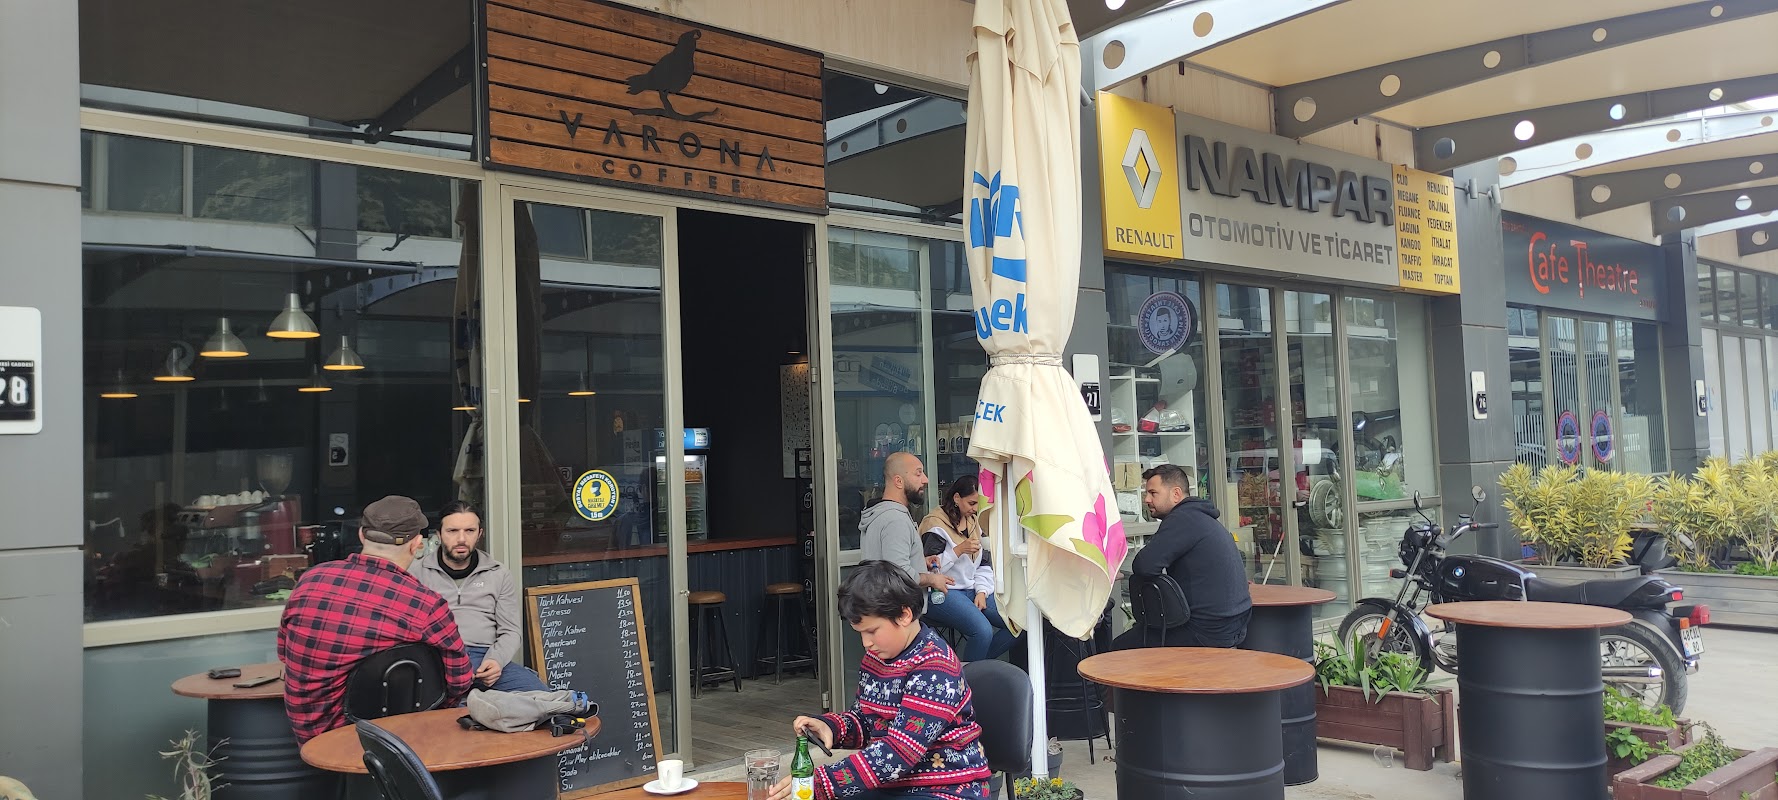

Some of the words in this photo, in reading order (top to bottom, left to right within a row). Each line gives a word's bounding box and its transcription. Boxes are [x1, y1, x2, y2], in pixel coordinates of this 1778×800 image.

[559, 109, 776, 172] VARONA
[602, 159, 742, 193] COFFEE
[1184, 134, 1394, 227] NAMPAR
[1426, 181, 1449, 196] RENAULT
[1397, 189, 1419, 204] MEGANE
[1398, 205, 1421, 220] FLUANCE
[1399, 221, 1420, 235] LAGUNA
[1116, 226, 1175, 251] RENAULT
[1188, 212, 1295, 251] OTOMOTİV
[1298, 231, 1322, 256] VE
[1323, 231, 1393, 266] TİCARET
[1400, 237, 1421, 251] KANGOO
[1401, 253, 1422, 267] TRAFFIC
[1528, 231, 1569, 294] Cafe
[1570, 240, 1639, 299] Theatre
[1402, 269, 1423, 282] MASTER
[1434, 273, 1454, 286] TOPTAN
[540, 607, 572, 618] Espresso
[564, 625, 587, 636] Kahve
[543, 638, 577, 649] Americano
[544, 648, 564, 660] Latte
[548, 669, 573, 680] Mocha
[561, 779, 574, 791] Su
